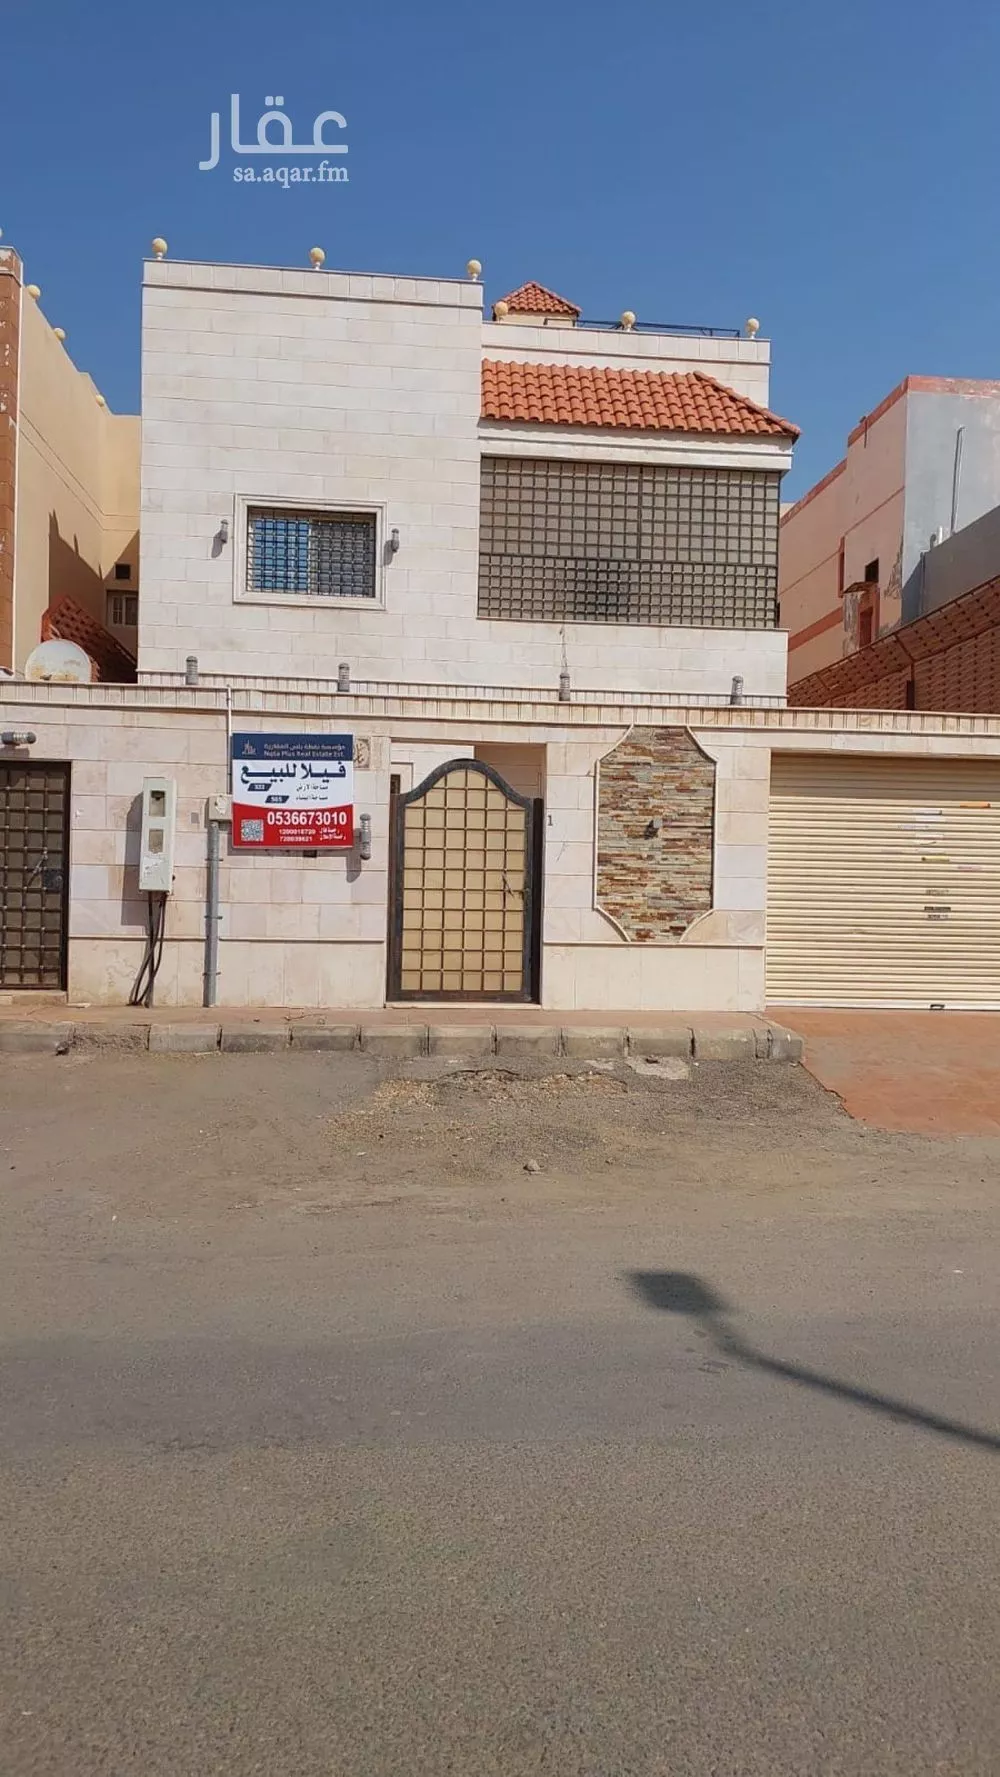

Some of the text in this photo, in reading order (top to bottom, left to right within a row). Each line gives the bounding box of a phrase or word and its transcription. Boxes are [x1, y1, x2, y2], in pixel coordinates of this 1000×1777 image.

[240, 761, 346, 784] فيلا للبيع
[267, 811, 347, 825] 0536673010
